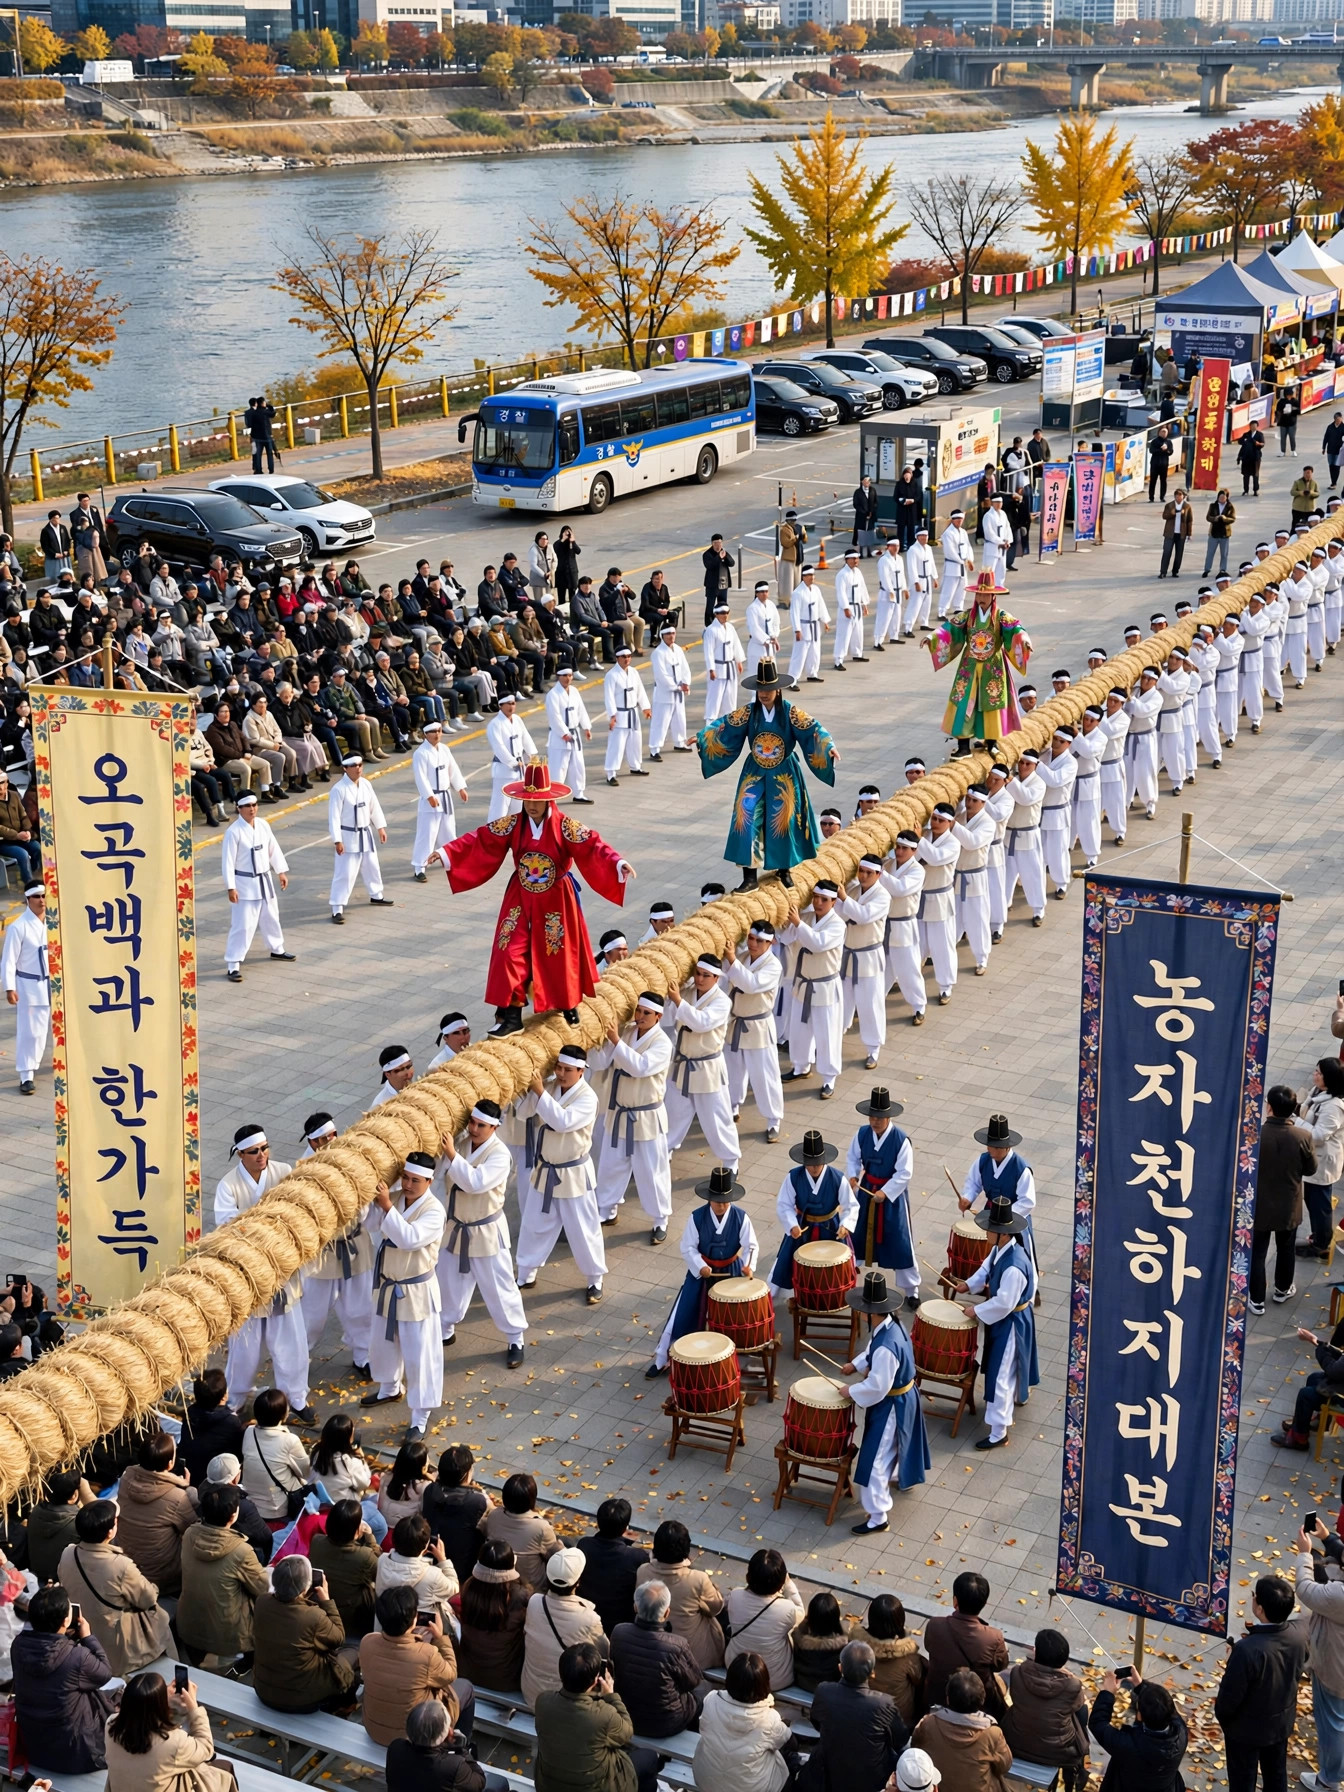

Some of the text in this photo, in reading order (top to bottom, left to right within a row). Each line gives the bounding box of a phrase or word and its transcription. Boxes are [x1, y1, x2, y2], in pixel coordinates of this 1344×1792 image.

[78, 752, 159, 1273] 오곡백과 한가득
[1108, 959, 1216, 1548] 농자천하지대본
